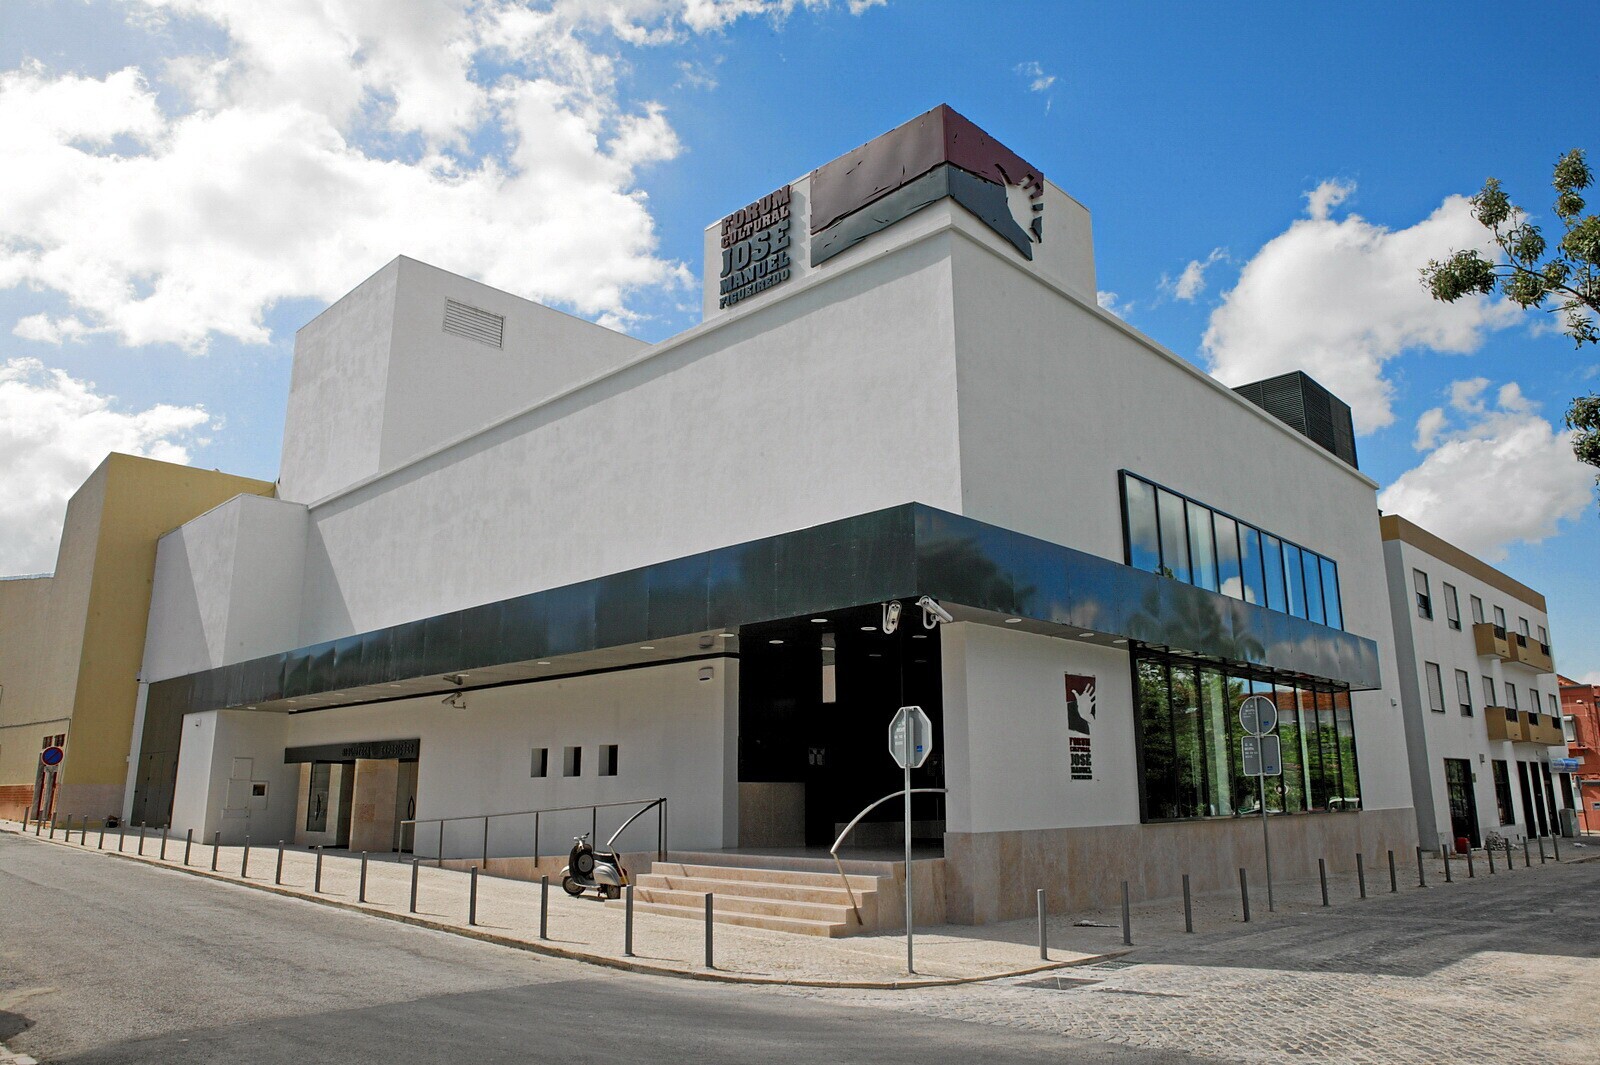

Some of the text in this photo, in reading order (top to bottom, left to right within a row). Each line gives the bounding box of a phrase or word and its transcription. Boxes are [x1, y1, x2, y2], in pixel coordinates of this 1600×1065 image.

[721, 185, 791, 236] FORUM
[721, 205, 790, 249] CULTURAL
[719, 269, 790, 309] FIGUEIREDO
[720, 251, 790, 295] MANUEL
